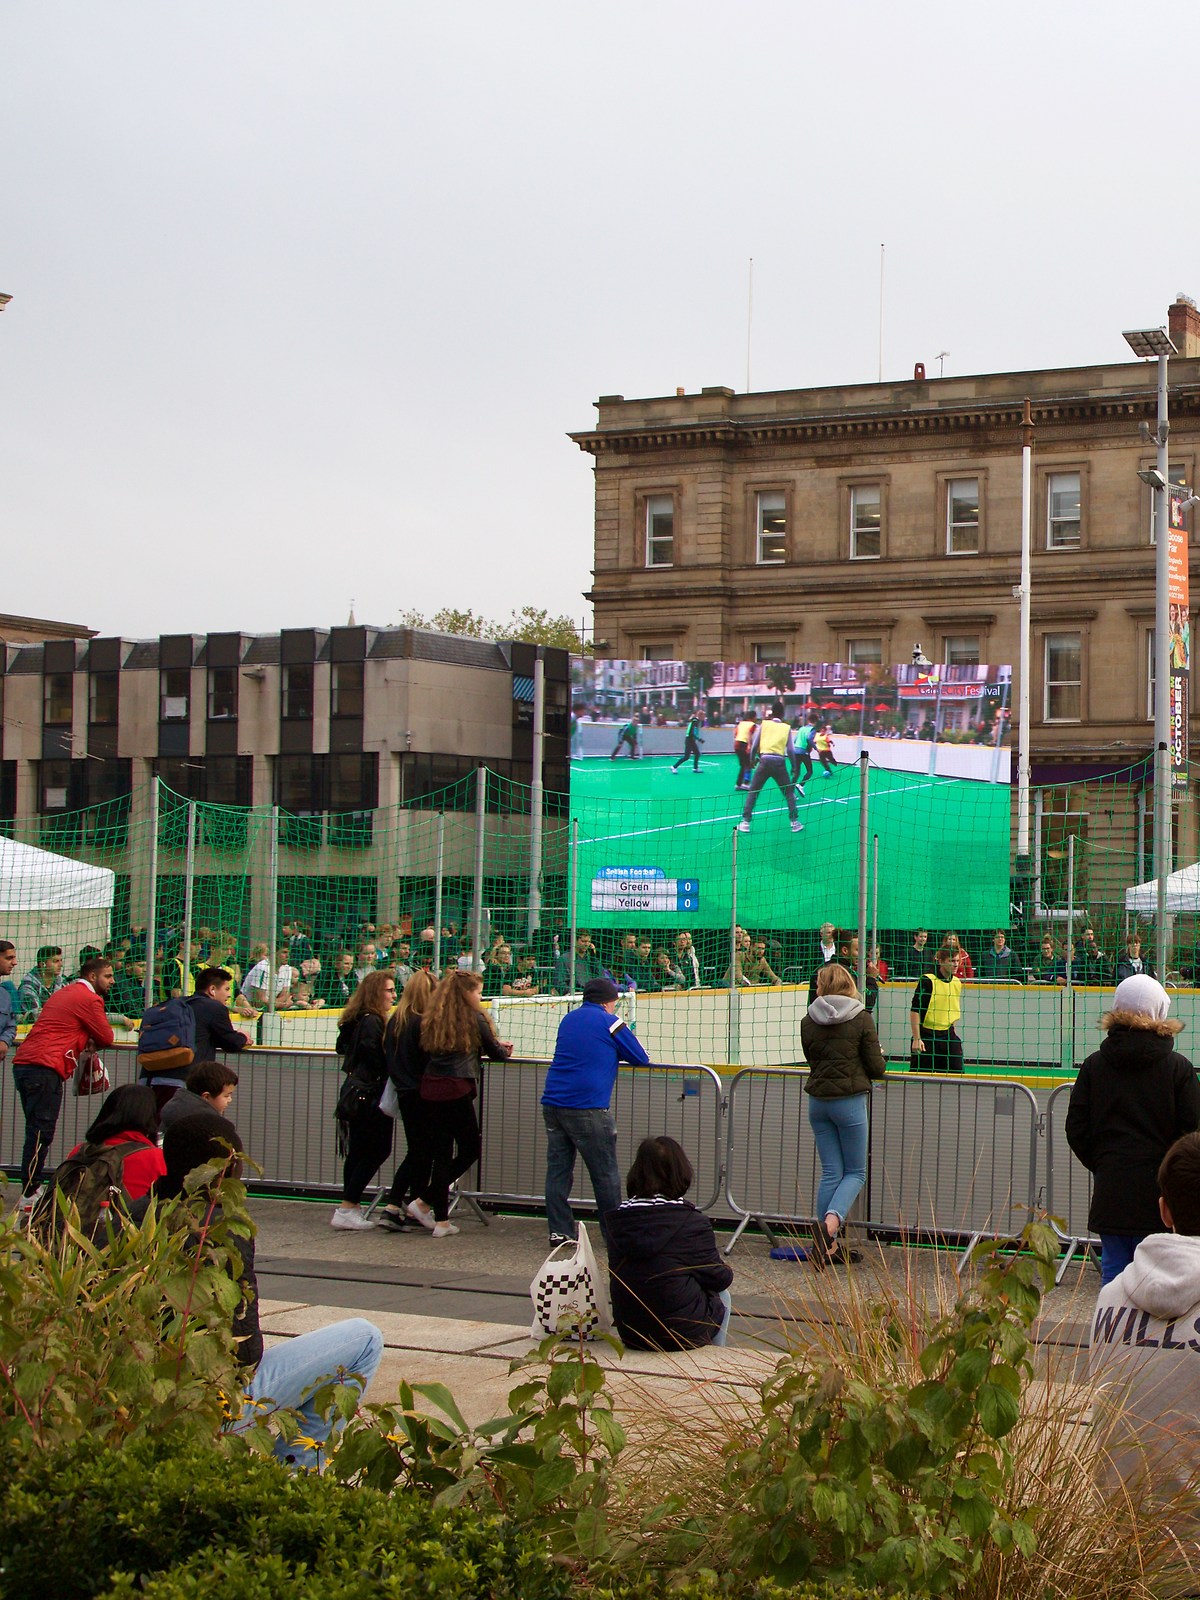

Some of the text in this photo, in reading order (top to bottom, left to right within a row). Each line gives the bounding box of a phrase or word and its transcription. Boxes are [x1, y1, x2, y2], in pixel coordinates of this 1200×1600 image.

[620, 882, 691, 891] Green 0
[618, 898, 691, 908] Yellow 0
